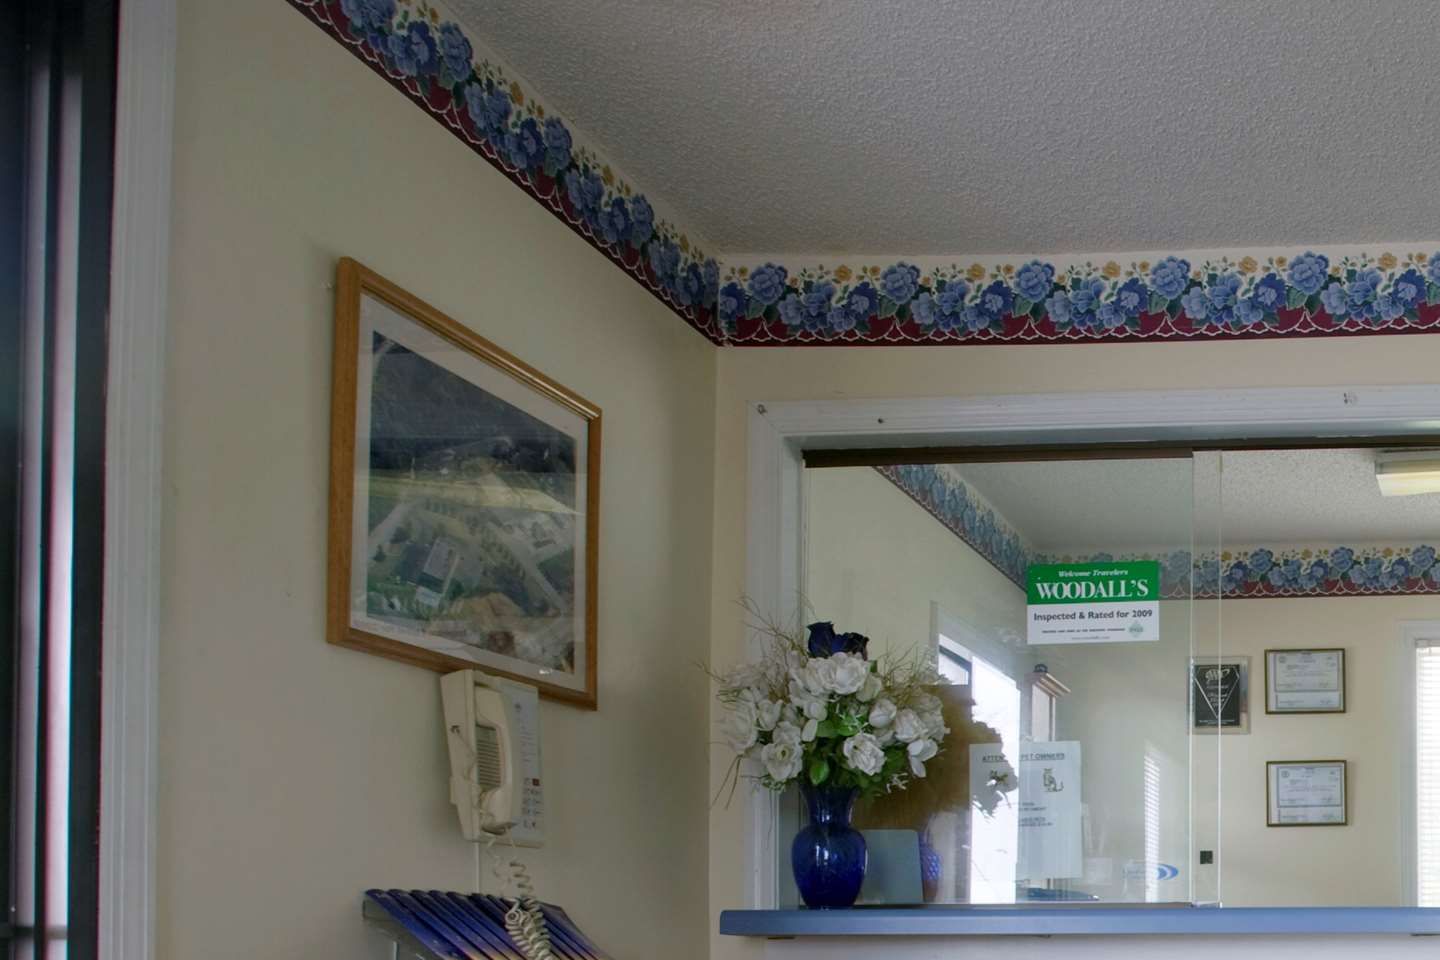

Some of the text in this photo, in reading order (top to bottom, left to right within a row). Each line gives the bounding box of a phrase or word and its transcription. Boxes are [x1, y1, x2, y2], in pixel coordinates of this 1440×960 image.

[1058, 569, 1129, 578] Welcome Travelers
[1036, 578, 1149, 600] WOODALL'S
[1034, 609, 1153, 623] Inspected & Rated for 2009
